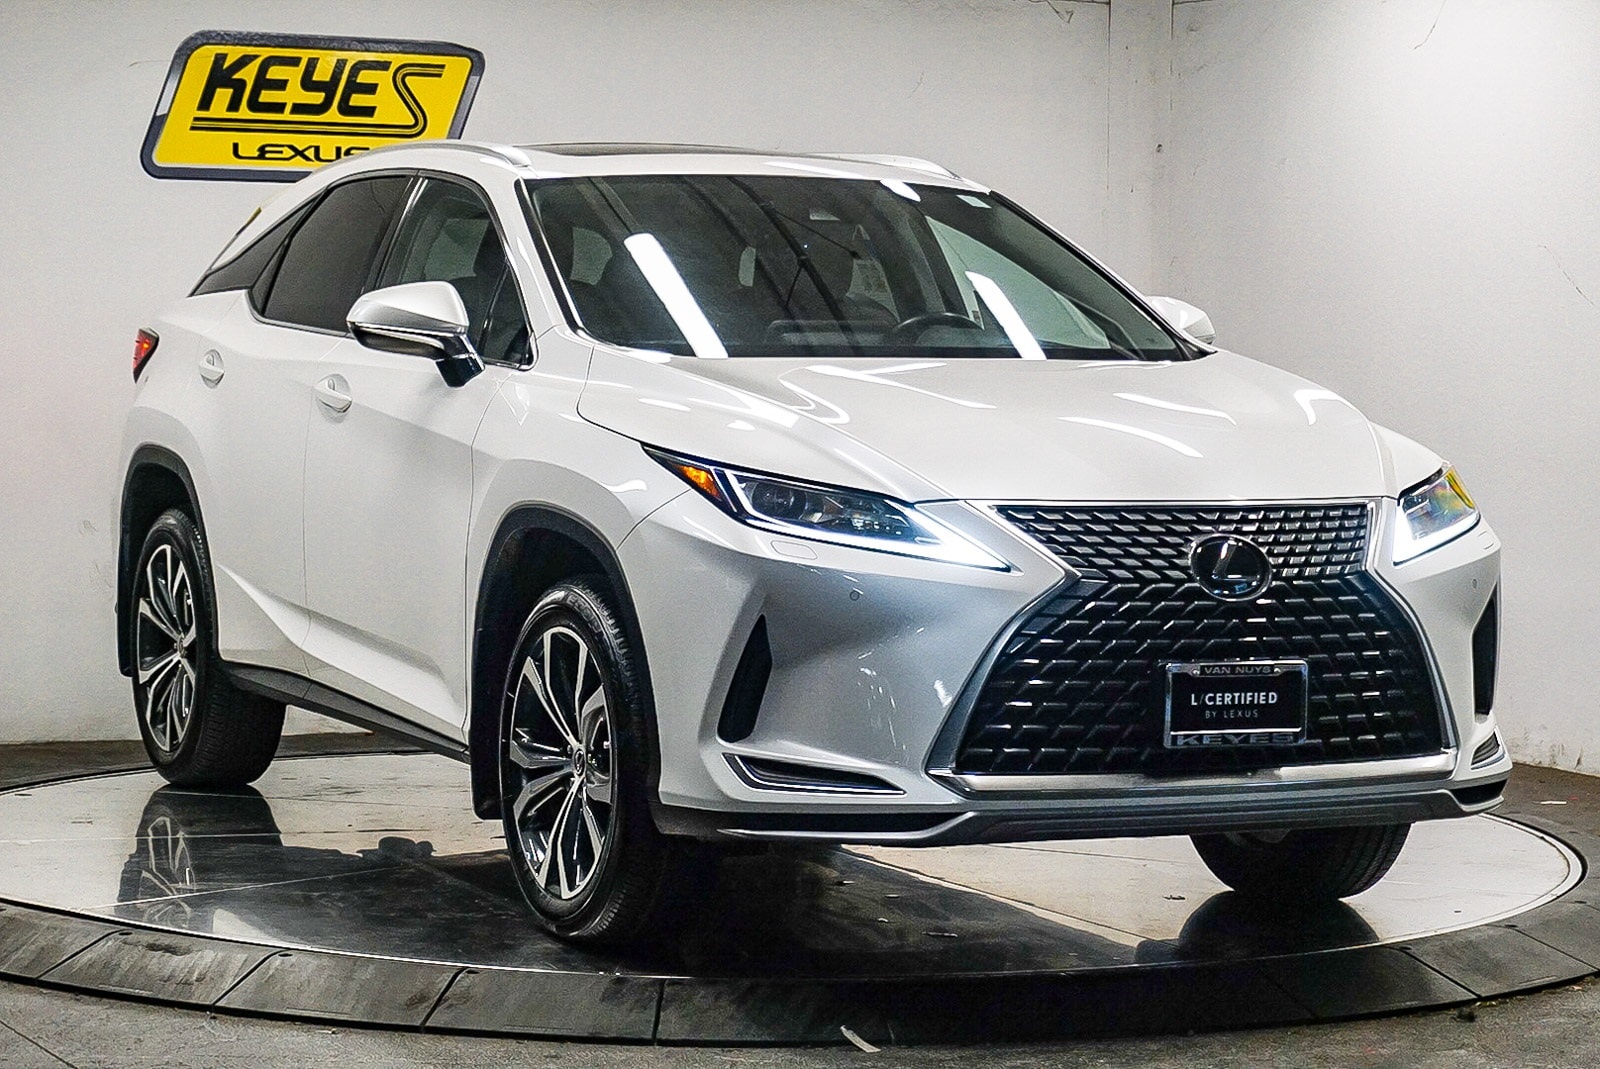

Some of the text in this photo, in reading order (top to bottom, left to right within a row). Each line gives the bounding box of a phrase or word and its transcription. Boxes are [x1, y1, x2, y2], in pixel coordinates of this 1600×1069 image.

[196, 52, 446, 137] KEYES
[1204, 665, 1271, 674] VAN NUYS
[1205, 709, 1259, 719] BY LEXUS
[1176, 732, 1294, 745] KEYES
